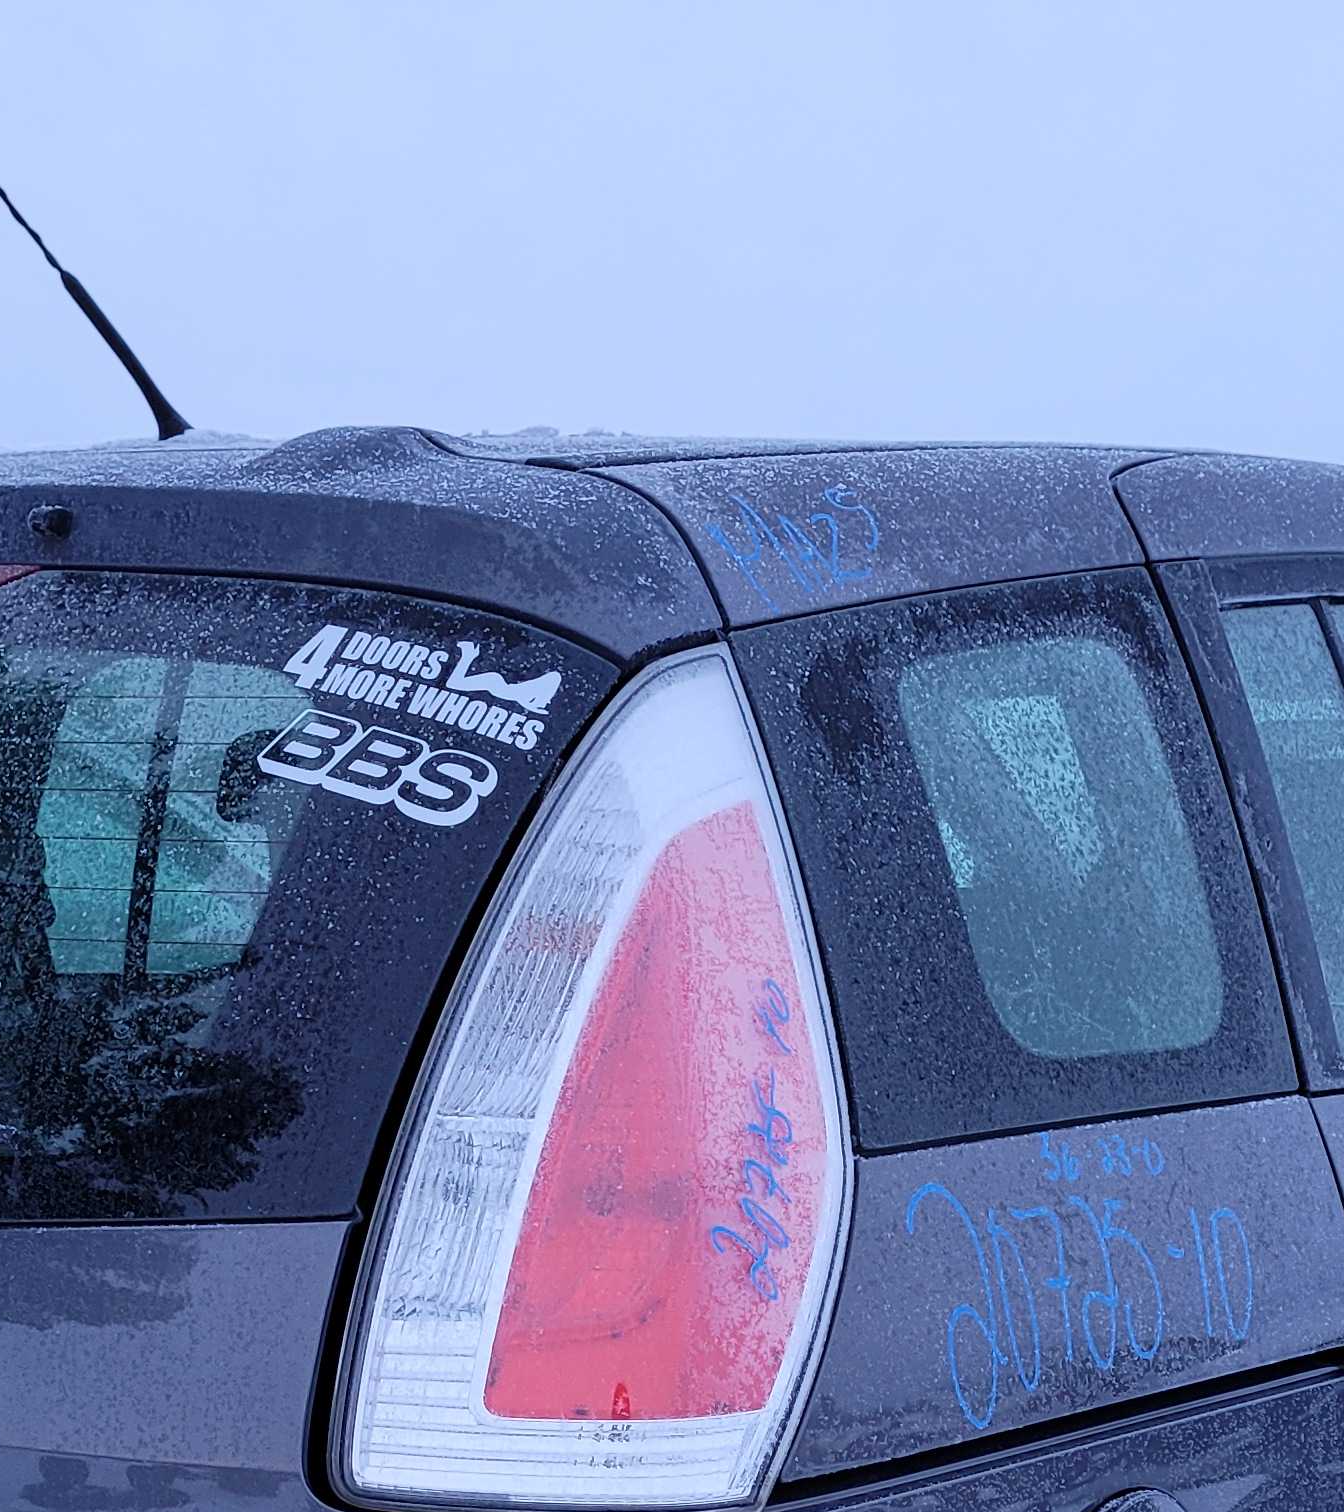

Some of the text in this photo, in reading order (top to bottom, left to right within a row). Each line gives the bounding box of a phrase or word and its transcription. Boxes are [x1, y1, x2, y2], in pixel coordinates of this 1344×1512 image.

[282, 624, 450, 690] 4 DOORS
[319, 665, 546, 752] MORE WHORES
[257, 708, 499, 827] BBS
